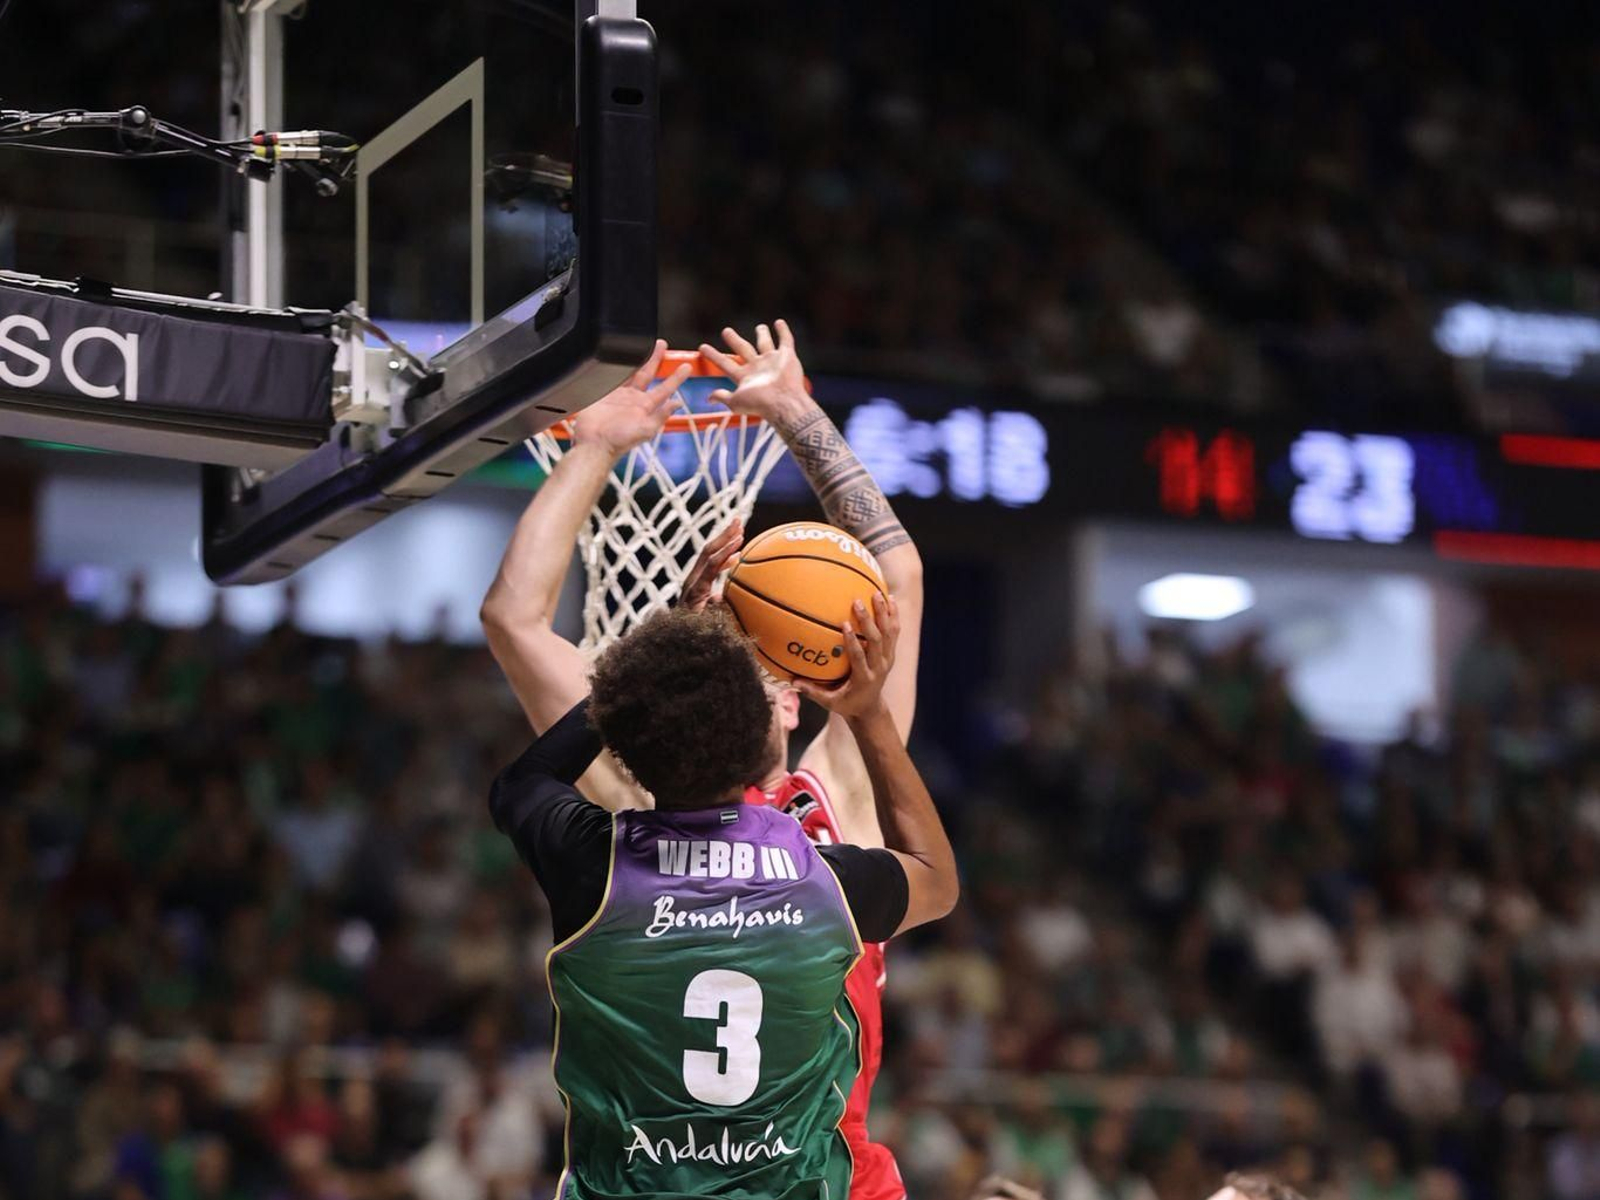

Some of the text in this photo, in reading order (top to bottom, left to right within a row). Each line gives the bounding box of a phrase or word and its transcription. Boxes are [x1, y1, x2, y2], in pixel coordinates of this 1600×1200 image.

[0, 314, 139, 401] sa
[1290, 430, 1415, 544] 23
[787, 641, 829, 666] acb
[657, 839, 799, 881] WEBB III
[682, 969, 763, 1107] 3
[623, 1121, 802, 1166] Andalucía
